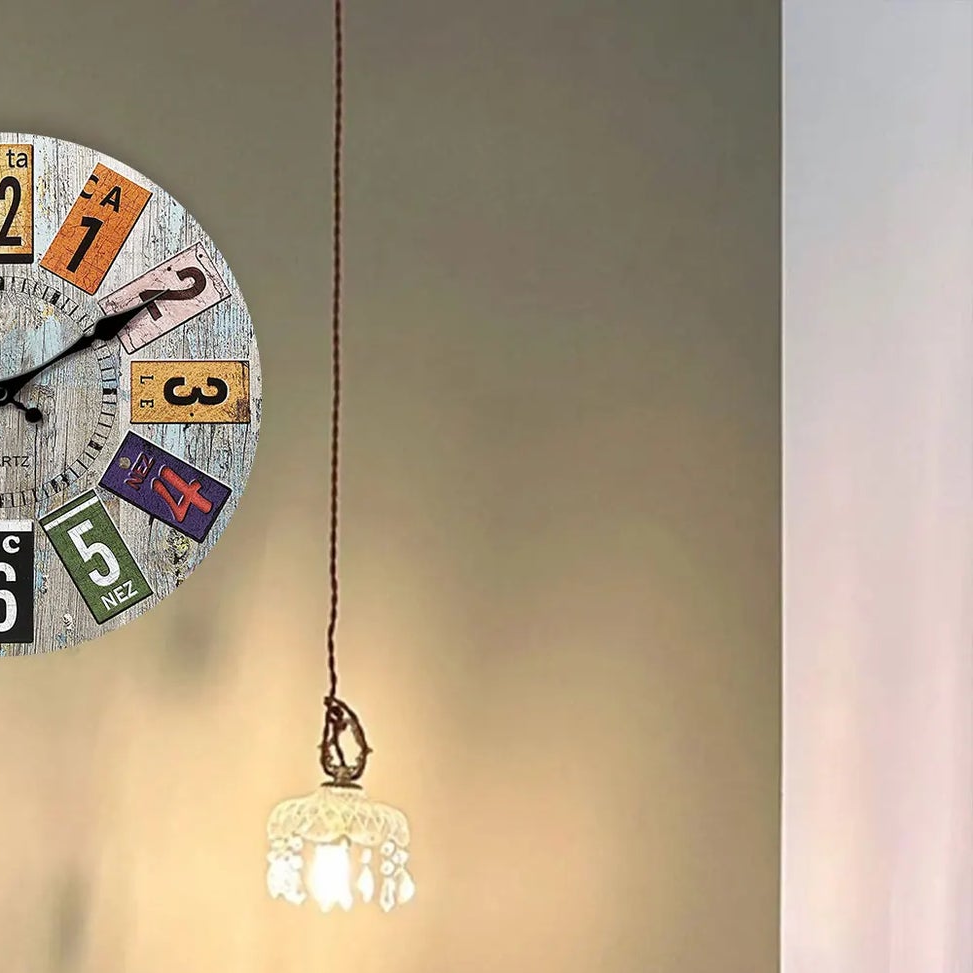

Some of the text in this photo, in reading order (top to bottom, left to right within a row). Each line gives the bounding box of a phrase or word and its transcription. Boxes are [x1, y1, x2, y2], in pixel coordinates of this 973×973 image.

[6, 149, 28, 168] ta
[66, 216, 104, 273] 1
[139, 267, 206, 321] 2
[163, 377, 228, 405] 3
[152, 465, 213, 523] 4
[67, 519, 120, 586] 5
[100, 579, 138, 611] NEZ
